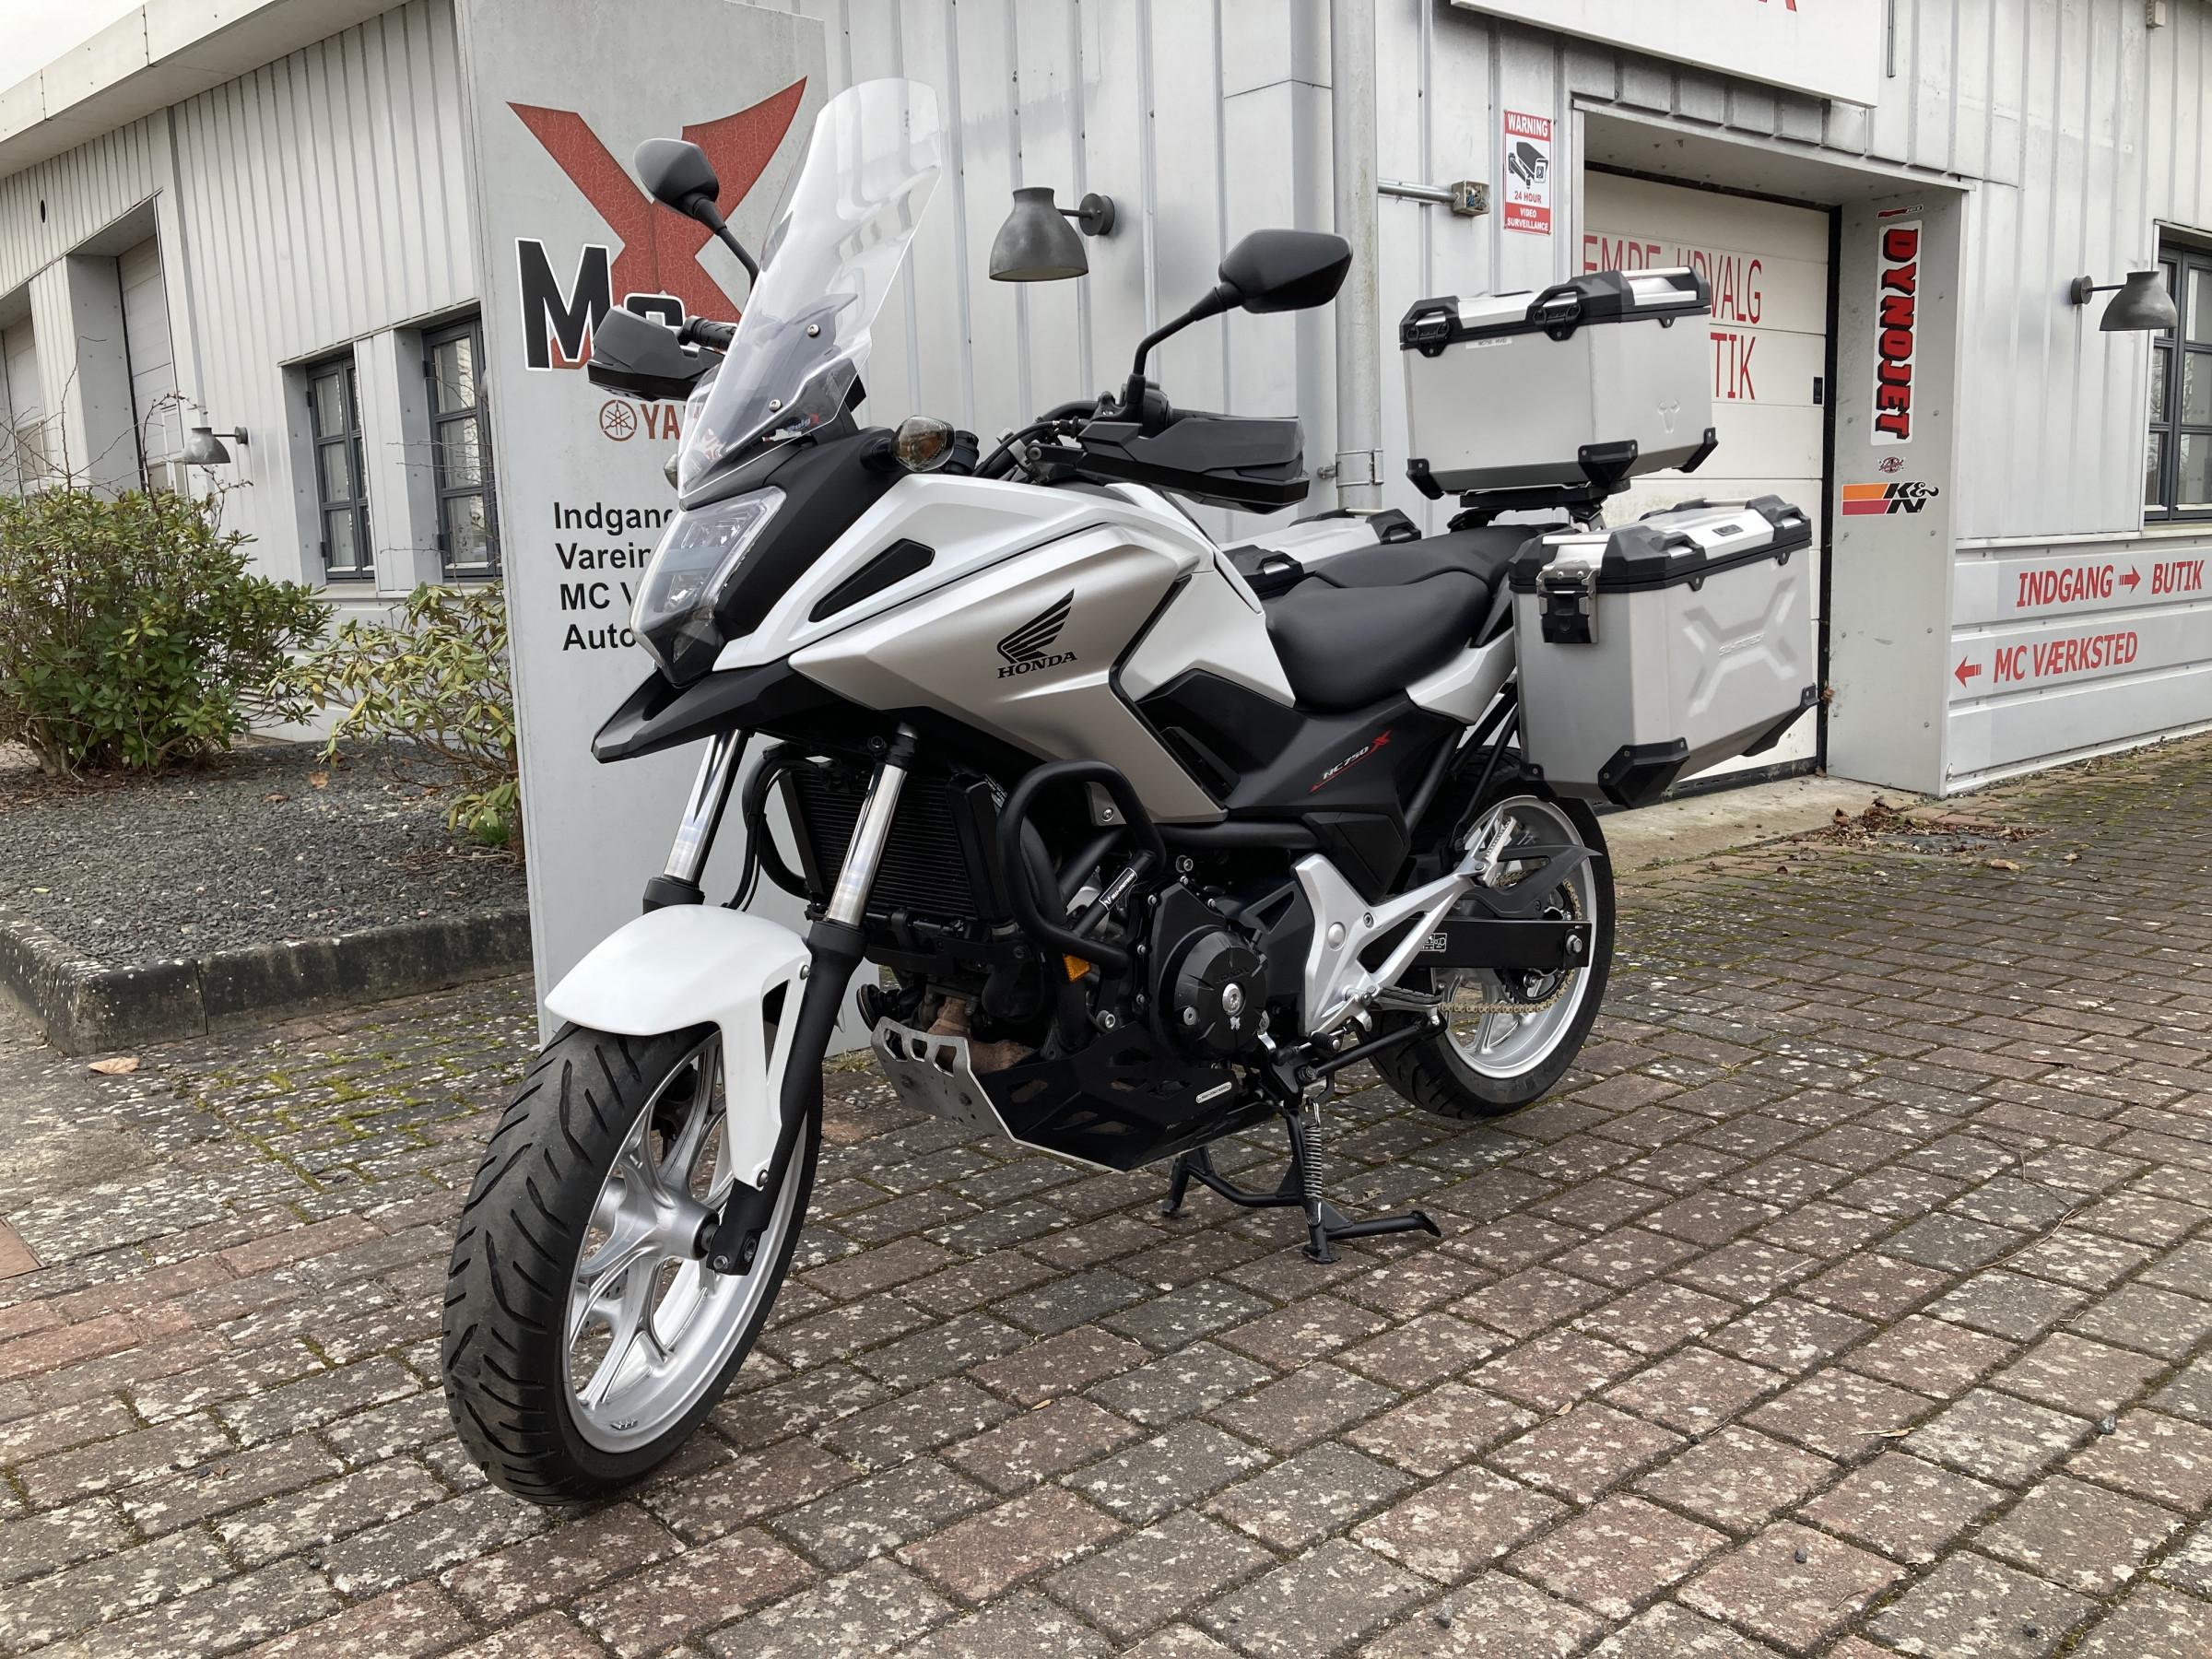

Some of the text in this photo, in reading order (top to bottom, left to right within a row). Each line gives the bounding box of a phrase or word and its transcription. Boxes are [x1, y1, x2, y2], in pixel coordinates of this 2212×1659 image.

[1507, 112, 1548, 137] WARNING
[1514, 190, 1541, 204] 24 HOUR
[1507, 218, 1548, 231] SURVEILLANCE
[1519, 207, 1537, 218] VIDEO
[1875, 228, 1919, 441] DYNOJET
[1711, 332, 1756, 400] TIK
[640, 403, 687, 441] YA
[559, 582, 610, 610] MC
[2017, 559, 2205, 607] INDGANG BUTIK
[997, 651, 1077, 679] HONDA
[1994, 631, 2138, 683] MC VÆRKSTED
